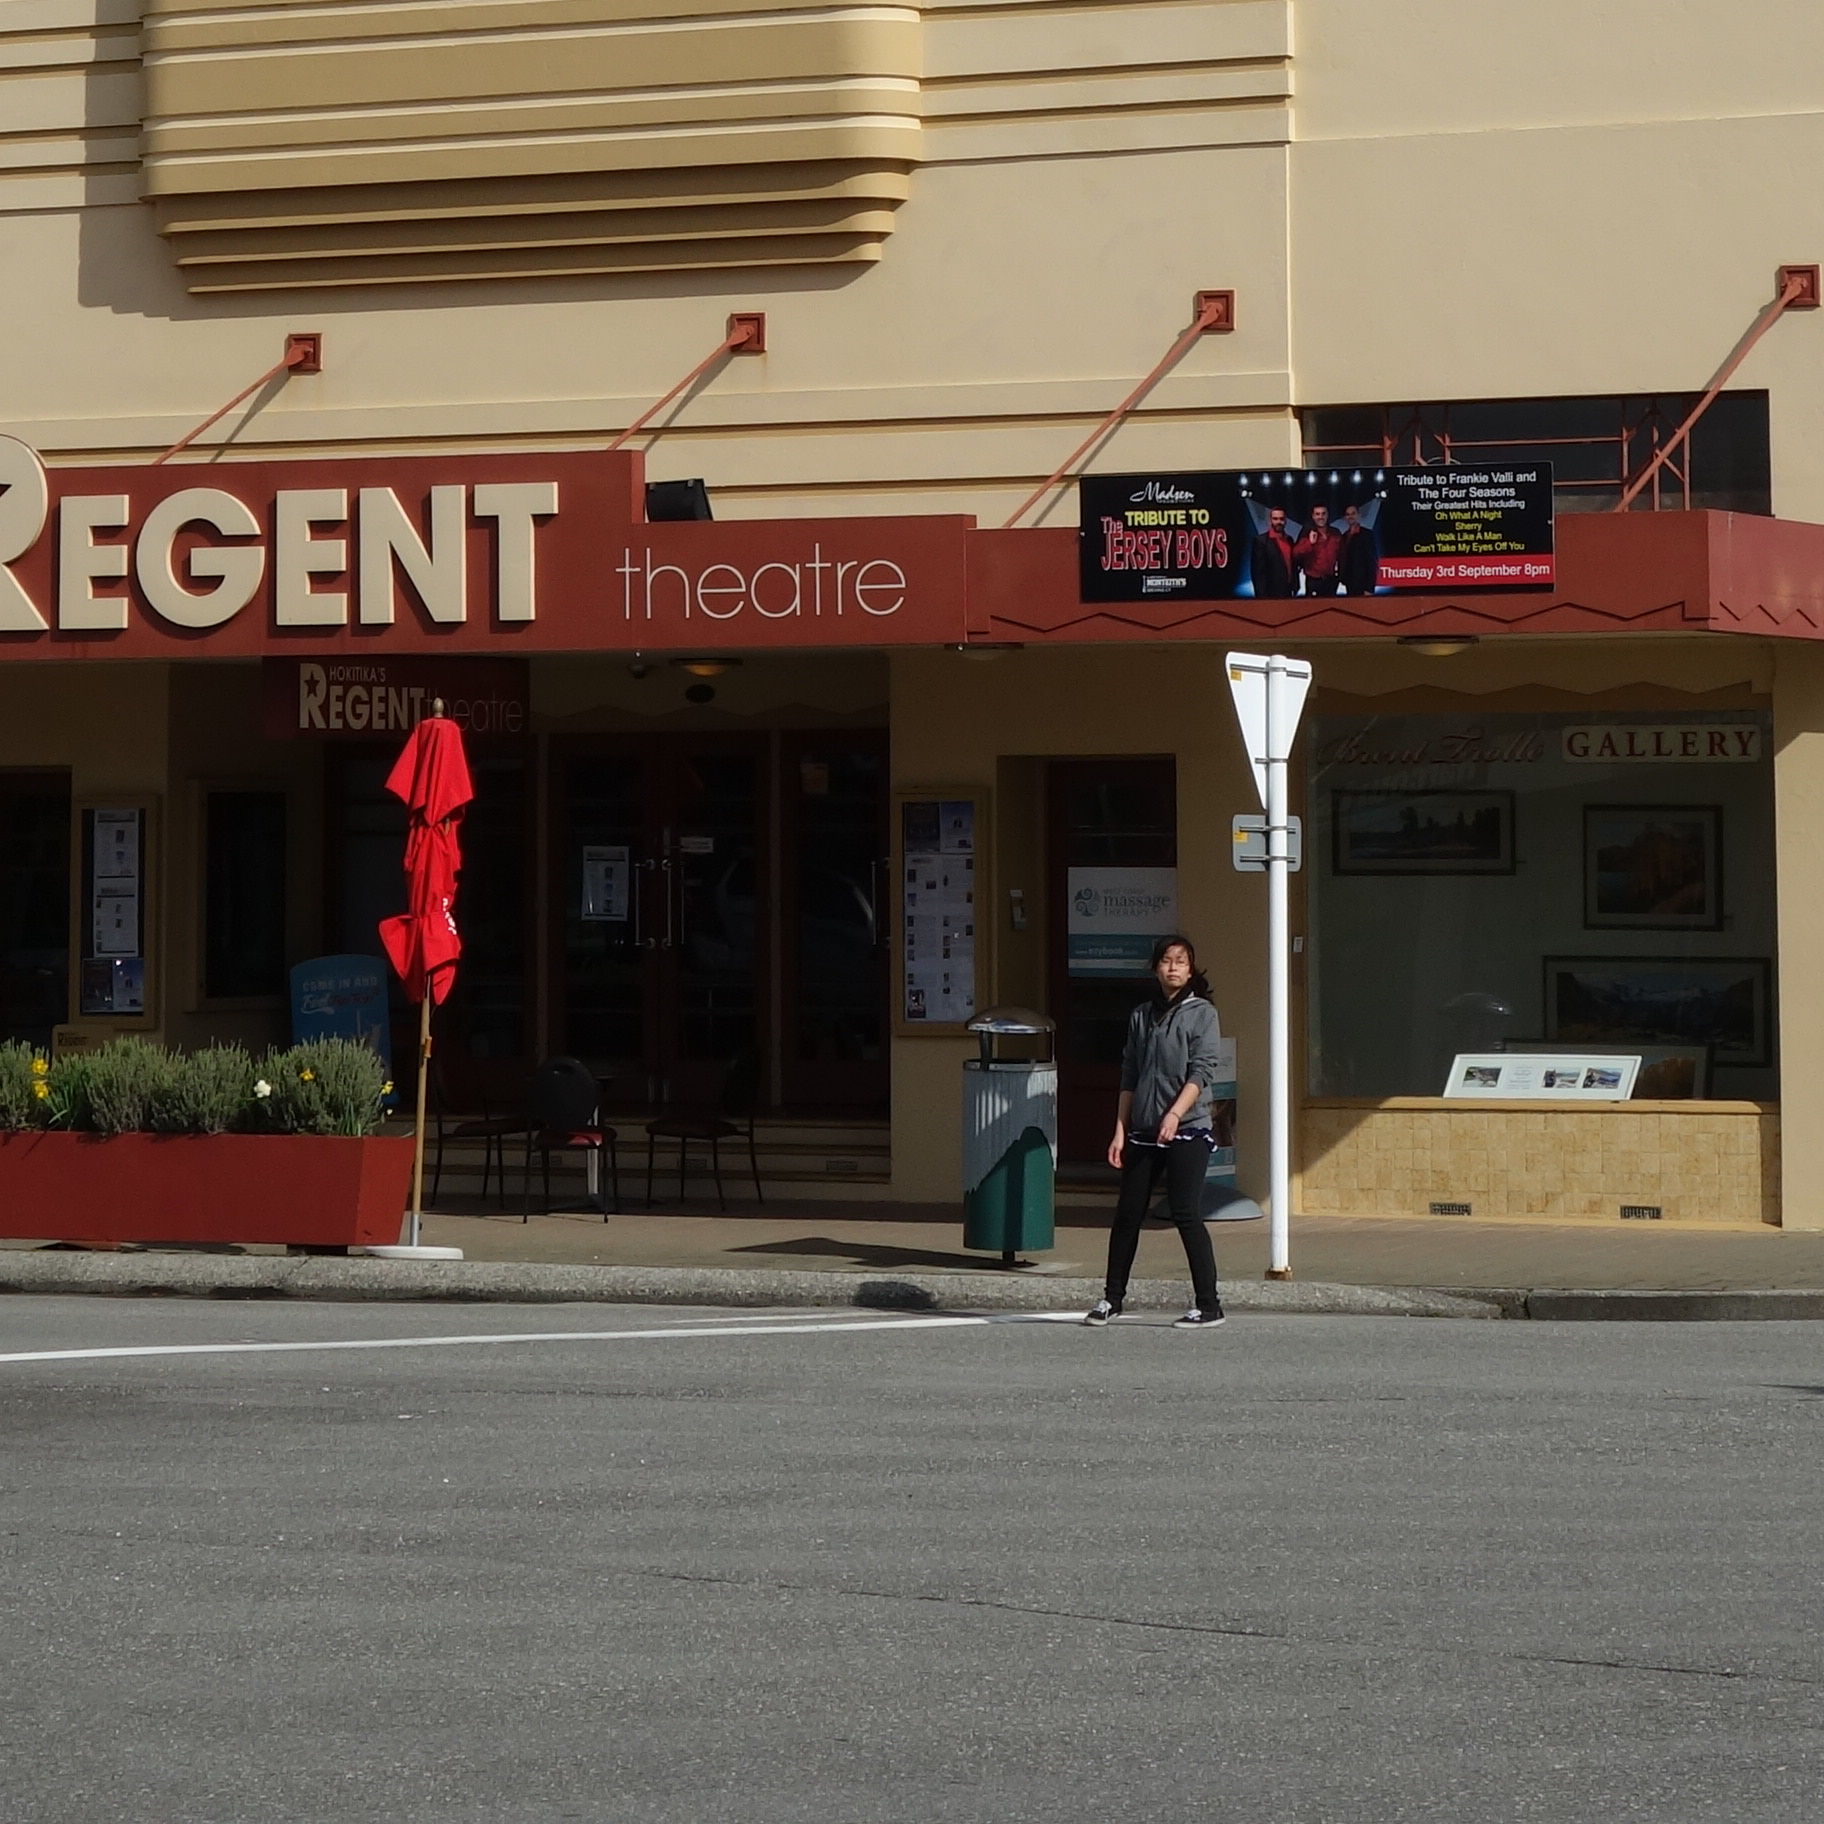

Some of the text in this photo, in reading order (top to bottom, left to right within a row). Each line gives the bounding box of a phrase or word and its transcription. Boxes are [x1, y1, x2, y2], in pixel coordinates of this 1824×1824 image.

[1397, 471, 1537, 486] Tribute to Frankie Valli and
[1130, 481, 1195, 502] Madsen
[1418, 486, 1516, 499] The Four Seasons
[1411, 499, 1526, 511] Their Greatest Hits Including
[1125, 508, 1210, 526] TRIBUTE TO
[1435, 510, 1502, 521] Oh What A Night
[1101, 517, 1123, 534] The
[1455, 521, 1483, 531] Sherry
[1435, 531, 1502, 542] Walk Like A Man
[1101, 528, 1228, 571] JERSEY BOYS
[1414, 541, 1525, 553] Can't Take My Eyes Off You
[1380, 563, 1550, 580] Thursday 3rd September 8pm
[615, 542, 906, 620] theatre
[329, 665, 387, 683] HOKITIKA'S
[299, 663, 425, 730] REGENT
[1566, 730, 1756, 758] GALLERY
[1104, 894, 1171, 914] massage
